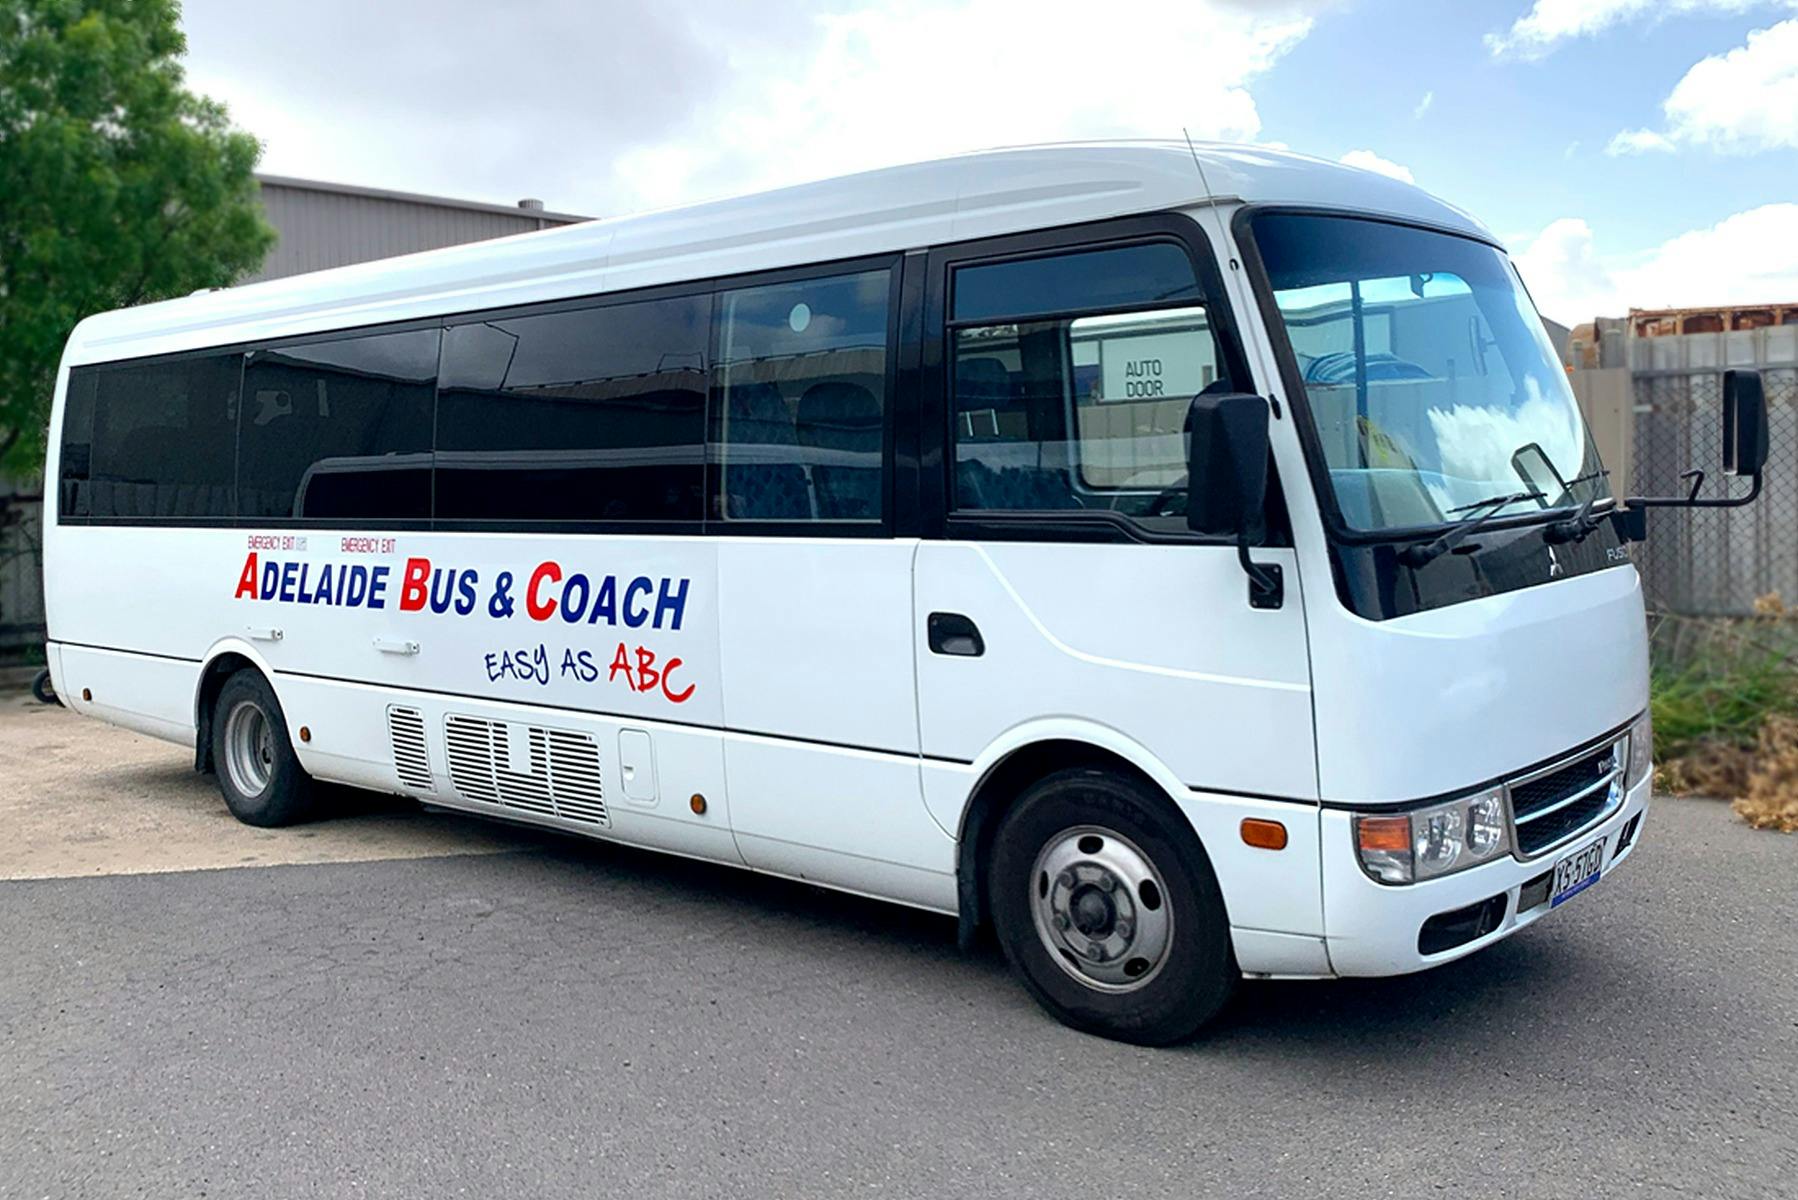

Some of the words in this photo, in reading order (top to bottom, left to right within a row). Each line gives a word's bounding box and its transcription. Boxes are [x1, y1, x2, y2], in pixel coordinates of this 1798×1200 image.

[1125, 359, 1162, 377] AUTO
[1126, 380, 1163, 397] DOOR
[248, 535, 280, 550] EMERGENCY
[282, 536, 295, 551] EXIT
[341, 537, 379, 553] EMERGENCY
[381, 538, 396, 554] EXIT
[235, 552, 390, 609] ADELAIDE
[400, 558, 479, 615] BUS
[488, 571, 514, 618] &
[526, 561, 690, 631] COACH
[485, 643, 549, 685] EASY
[561, 648, 599, 683] AS
[609, 643, 696, 704] ABC
